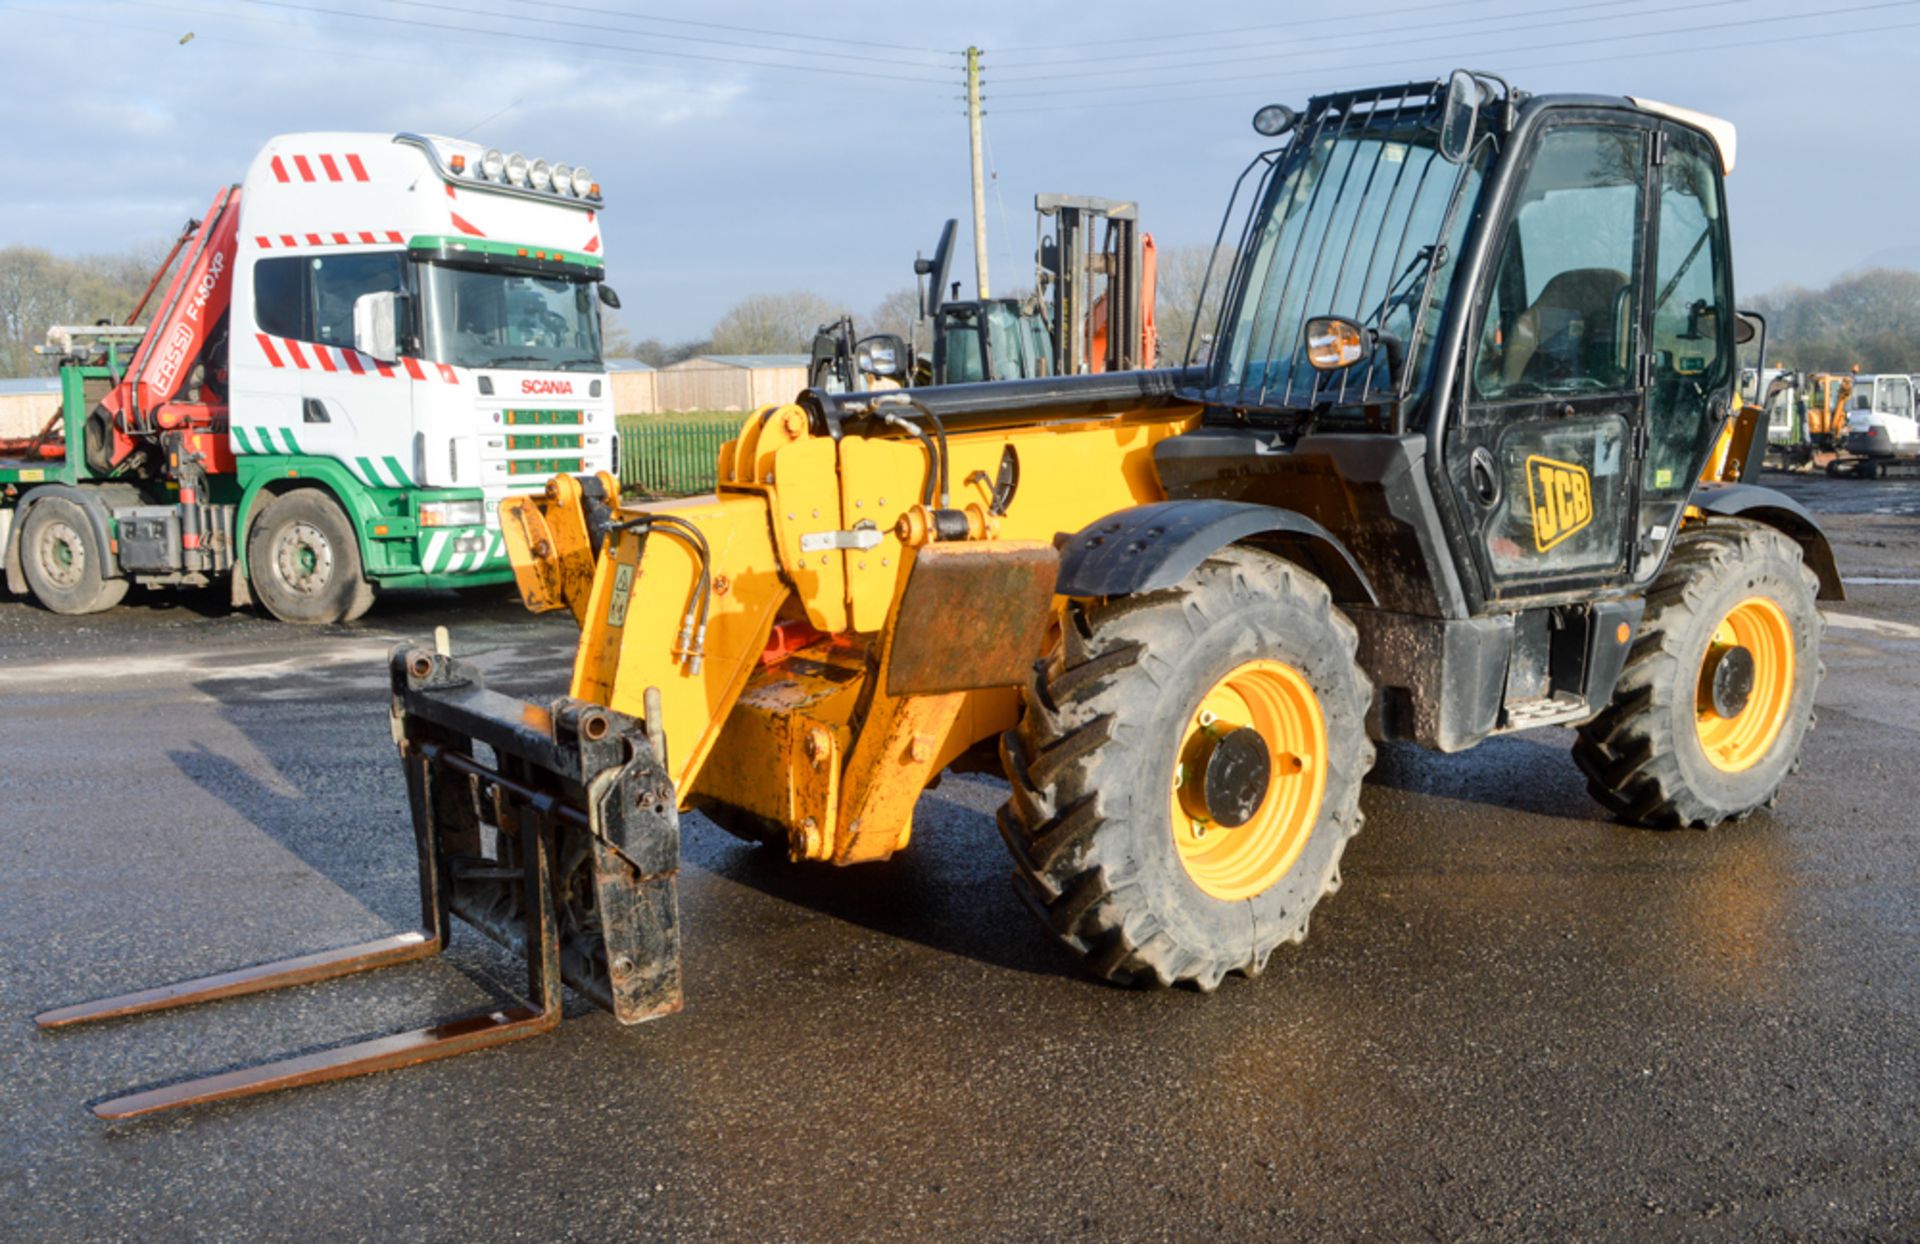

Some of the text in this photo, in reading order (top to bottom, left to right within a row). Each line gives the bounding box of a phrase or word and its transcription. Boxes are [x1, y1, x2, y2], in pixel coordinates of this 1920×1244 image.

[154, 325, 193, 390] FASSI
[521, 379, 573, 394] SCANIA
[1538, 466, 1588, 541] JCB
